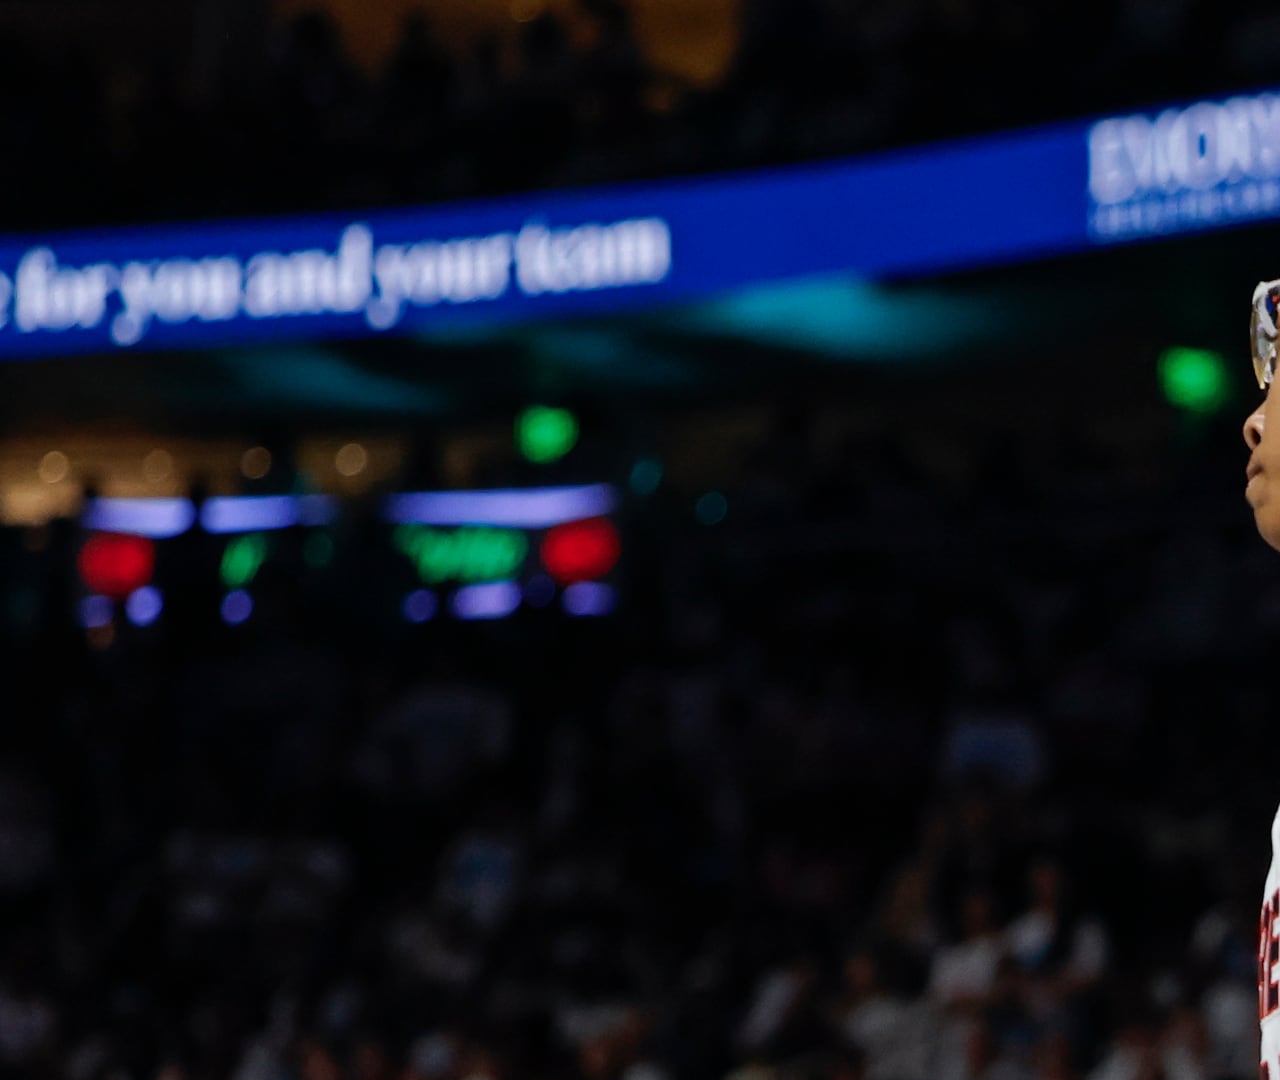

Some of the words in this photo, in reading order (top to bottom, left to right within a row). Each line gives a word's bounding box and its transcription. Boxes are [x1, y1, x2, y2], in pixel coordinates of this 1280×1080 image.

[15, 246, 118, 333] for
[111, 255, 242, 346] you
[243, 223, 373, 318] and
[366, 231, 514, 330] your
[515, 215, 672, 295] team
